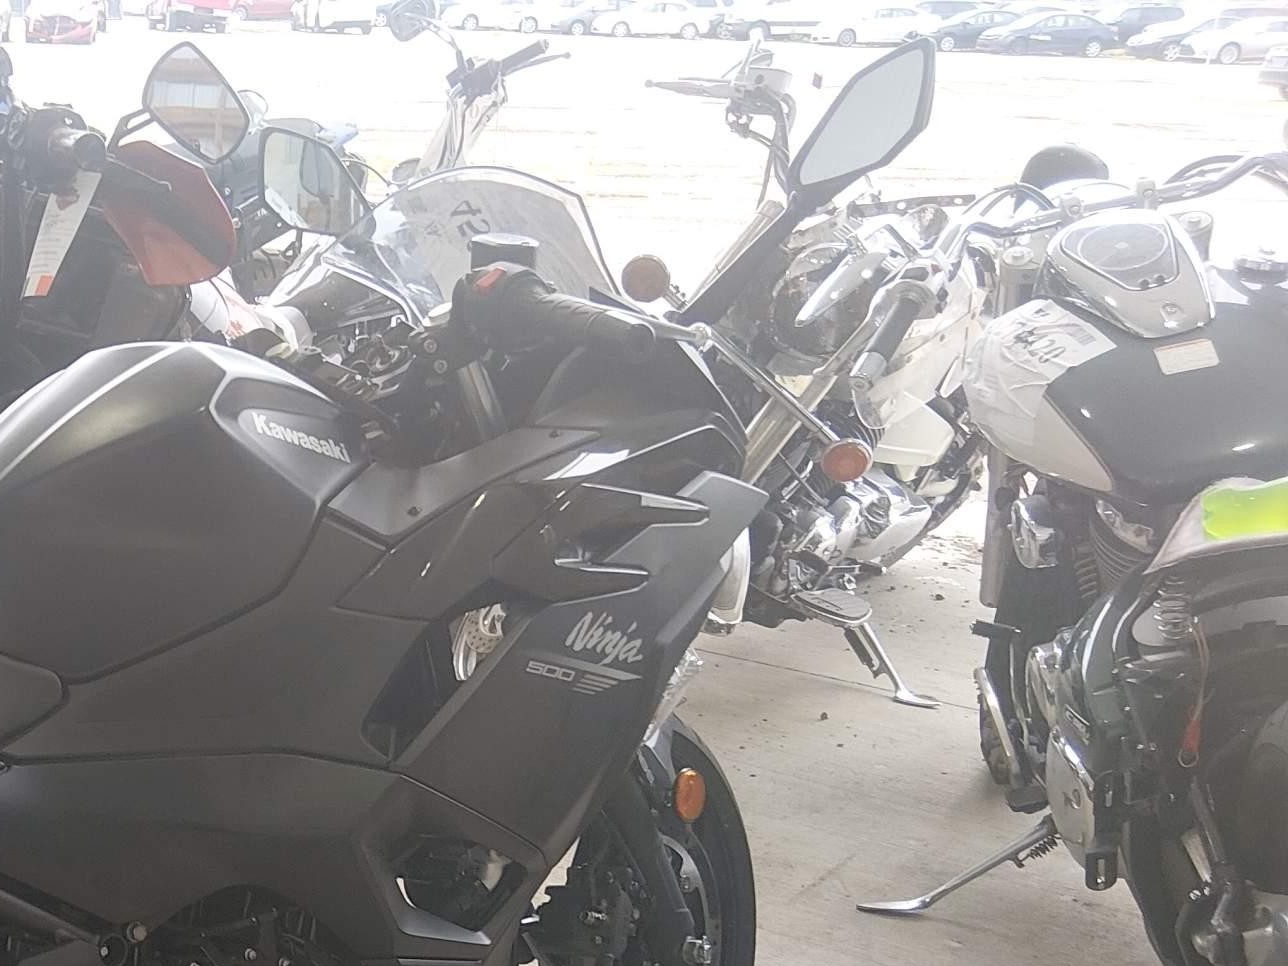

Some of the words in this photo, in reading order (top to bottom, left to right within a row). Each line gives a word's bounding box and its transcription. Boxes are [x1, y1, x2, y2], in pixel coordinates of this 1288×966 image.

[252, 411, 352, 464] Kawasaki
[564, 611, 643, 666] Ninja
[525, 660, 576, 682] 500
